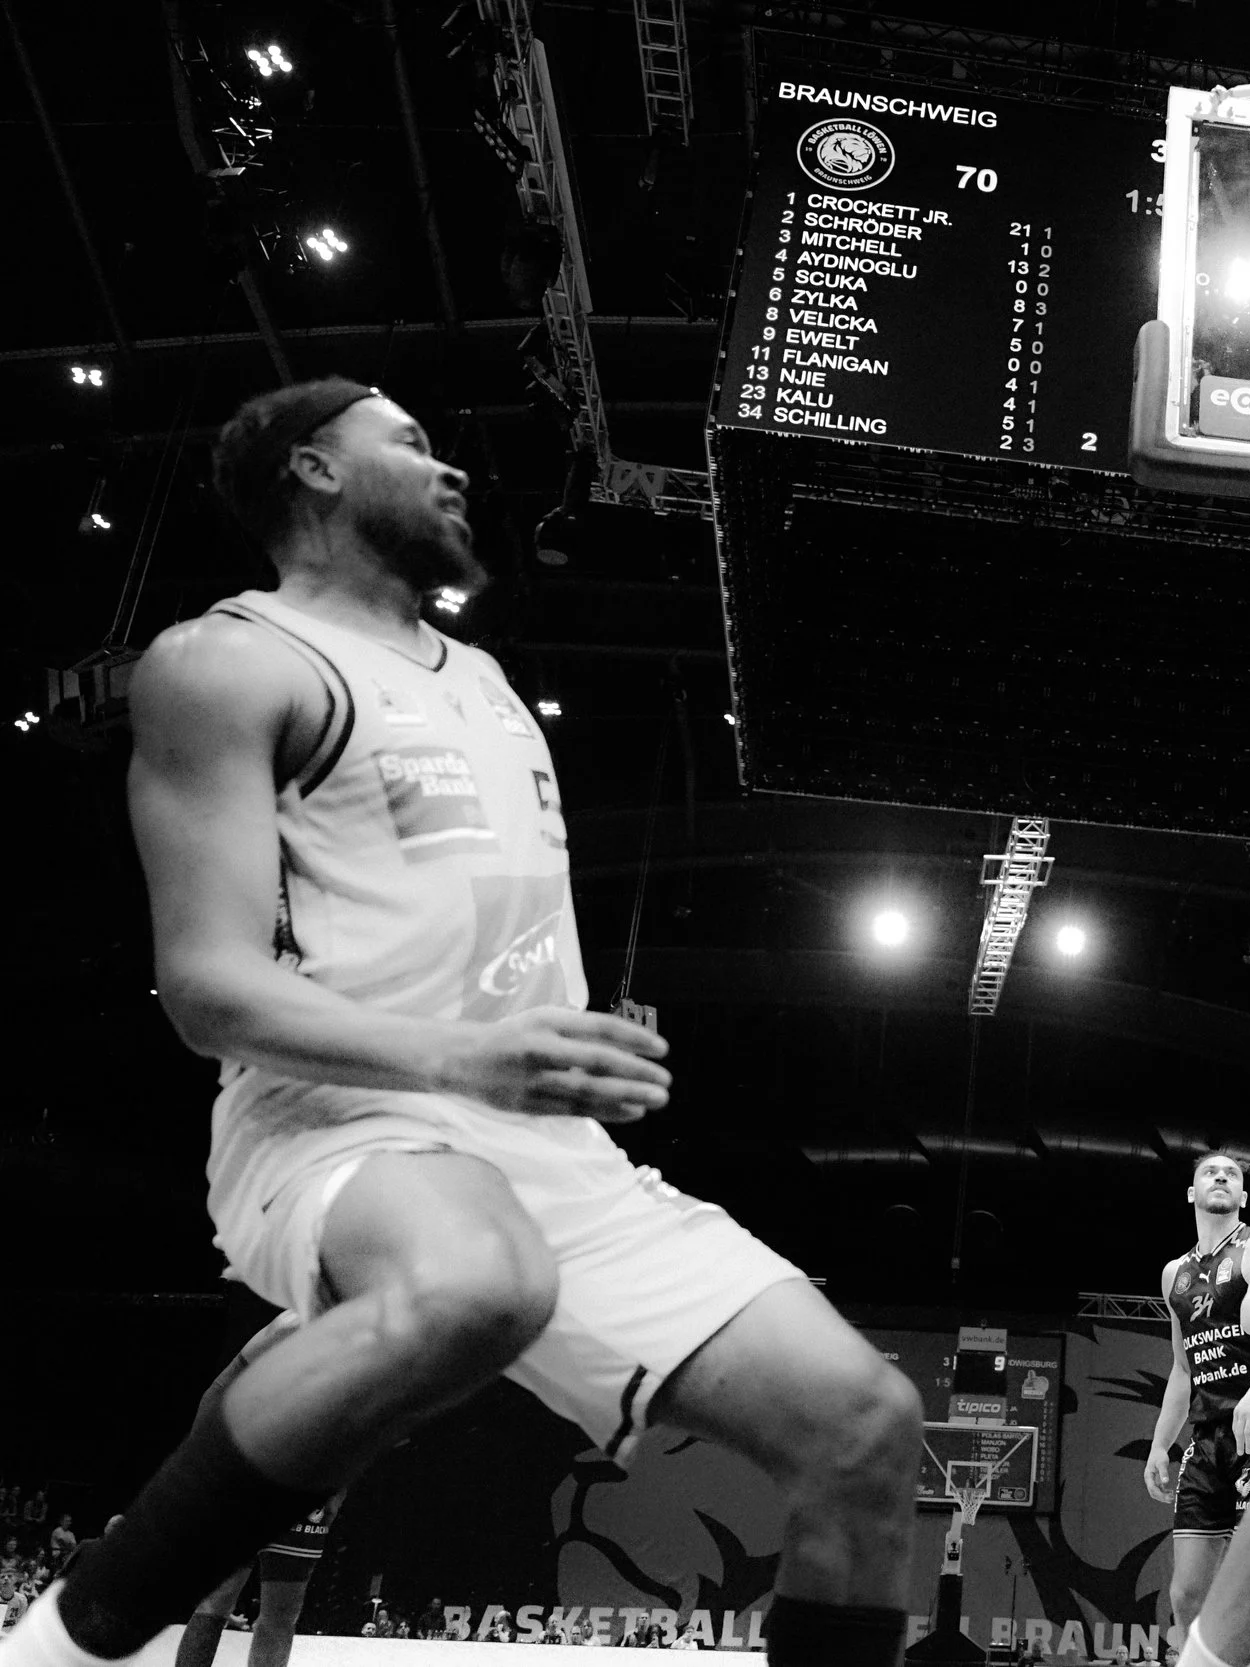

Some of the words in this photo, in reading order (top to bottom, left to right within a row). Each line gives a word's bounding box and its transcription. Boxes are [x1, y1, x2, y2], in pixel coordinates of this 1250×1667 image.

[778, 81, 999, 128] BRAUNSCHWEIG
[807, 123, 862, 144] BASKETBALL
[862, 128, 888, 154] LÖWEN
[813, 167, 873, 185] BRAUNSCHWEIG
[956, 164, 998, 193] 70
[786, 192, 796, 205] 1
[807, 193, 920, 221] CROCKETT
[922, 209, 953, 226] JR.
[781, 210, 795, 224] 2
[803, 211, 923, 241] SCHRÖDER
[1009, 222, 1031, 237] 21
[1044, 226, 1052, 240] 1
[778, 229, 791, 243] 3
[801, 230, 902, 258] MITCHELL
[1021, 242, 1029, 256] 1
[1040, 245, 1053, 259] 0
[774, 248, 788, 262] 4
[796, 250, 918, 279] AYDINOGLU
[1007, 259, 1029, 275] 13
[1038, 263, 1051, 278] 2
[772, 267, 785, 282] 5
[794, 269, 868, 292] SCUKA
[1015, 279, 1028, 294] 0
[1037, 282, 1049, 297] 0
[769, 287, 782, 302] 6
[790, 288, 858, 311] ZYLKA
[1013, 298, 1026, 313] 8
[1035, 301, 1047, 316] 3
[765, 306, 779, 321] 8
[789, 308, 878, 334] VELICKA
[1012, 318, 1025, 333] 7
[1035, 321, 1043, 336] 1
[762, 326, 776, 341] 9
[785, 328, 860, 351] EWELT
[1009, 337, 1022, 352] 5
[1031, 340, 1044, 355] 0
[751, 345, 771, 361] 11
[782, 348, 889, 376] FLANIGAN
[1007, 357, 1020, 372] 0
[1029, 360, 1042, 375] 0
[746, 364, 769, 381] 13
[779, 367, 827, 388] NJIE
[1005, 377, 1018, 392] 4
[1029, 380, 1038, 394] 1
[740, 383, 766, 400] 23
[776, 387, 834, 409] KALU
[1003, 396, 1016, 411] 4
[1027, 399, 1036, 414] 1
[737, 402, 763, 420] 34
[773, 406, 887, 435] SCHILLING
[1001, 415, 1015, 431] 5
[1025, 418, 1034, 433] 1
[999, 434, 1013, 450] 2
[1022, 437, 1035, 452] 3
[1080, 432, 1098, 452] 2
[1189, 1292, 1215, 1323] 34
[994, 1355, 1006, 1372] 9
[1193, 1345, 1227, 1365] BANK
[956, 1398, 1002, 1414] tipico
[443, 1603, 768, 1649] BASKETBALL
